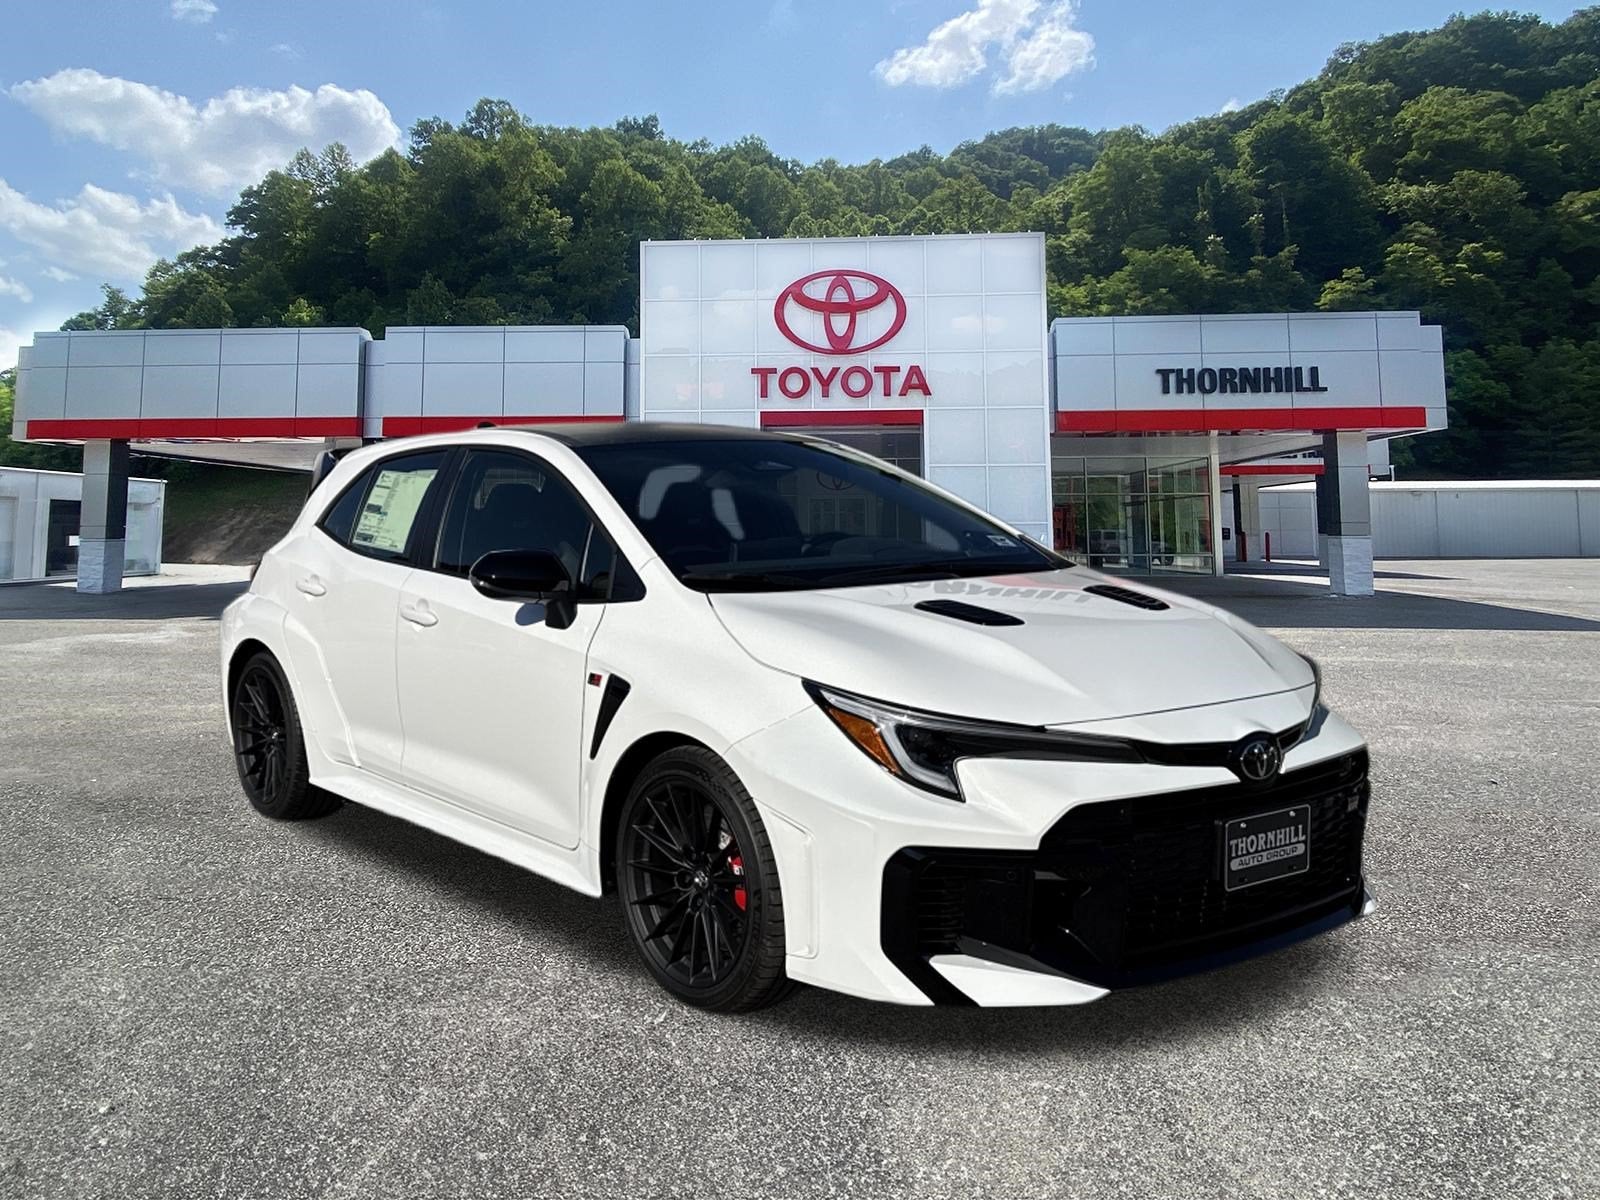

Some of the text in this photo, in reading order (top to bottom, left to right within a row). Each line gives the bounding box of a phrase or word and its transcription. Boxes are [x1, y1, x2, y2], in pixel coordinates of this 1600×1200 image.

[751, 365, 932, 399] TOYOTA
[1156, 366, 1328, 394] THORNHILL
[1229, 824, 1306, 857] THORNHILL
[1238, 846, 1298, 867] AUTO GROUP
